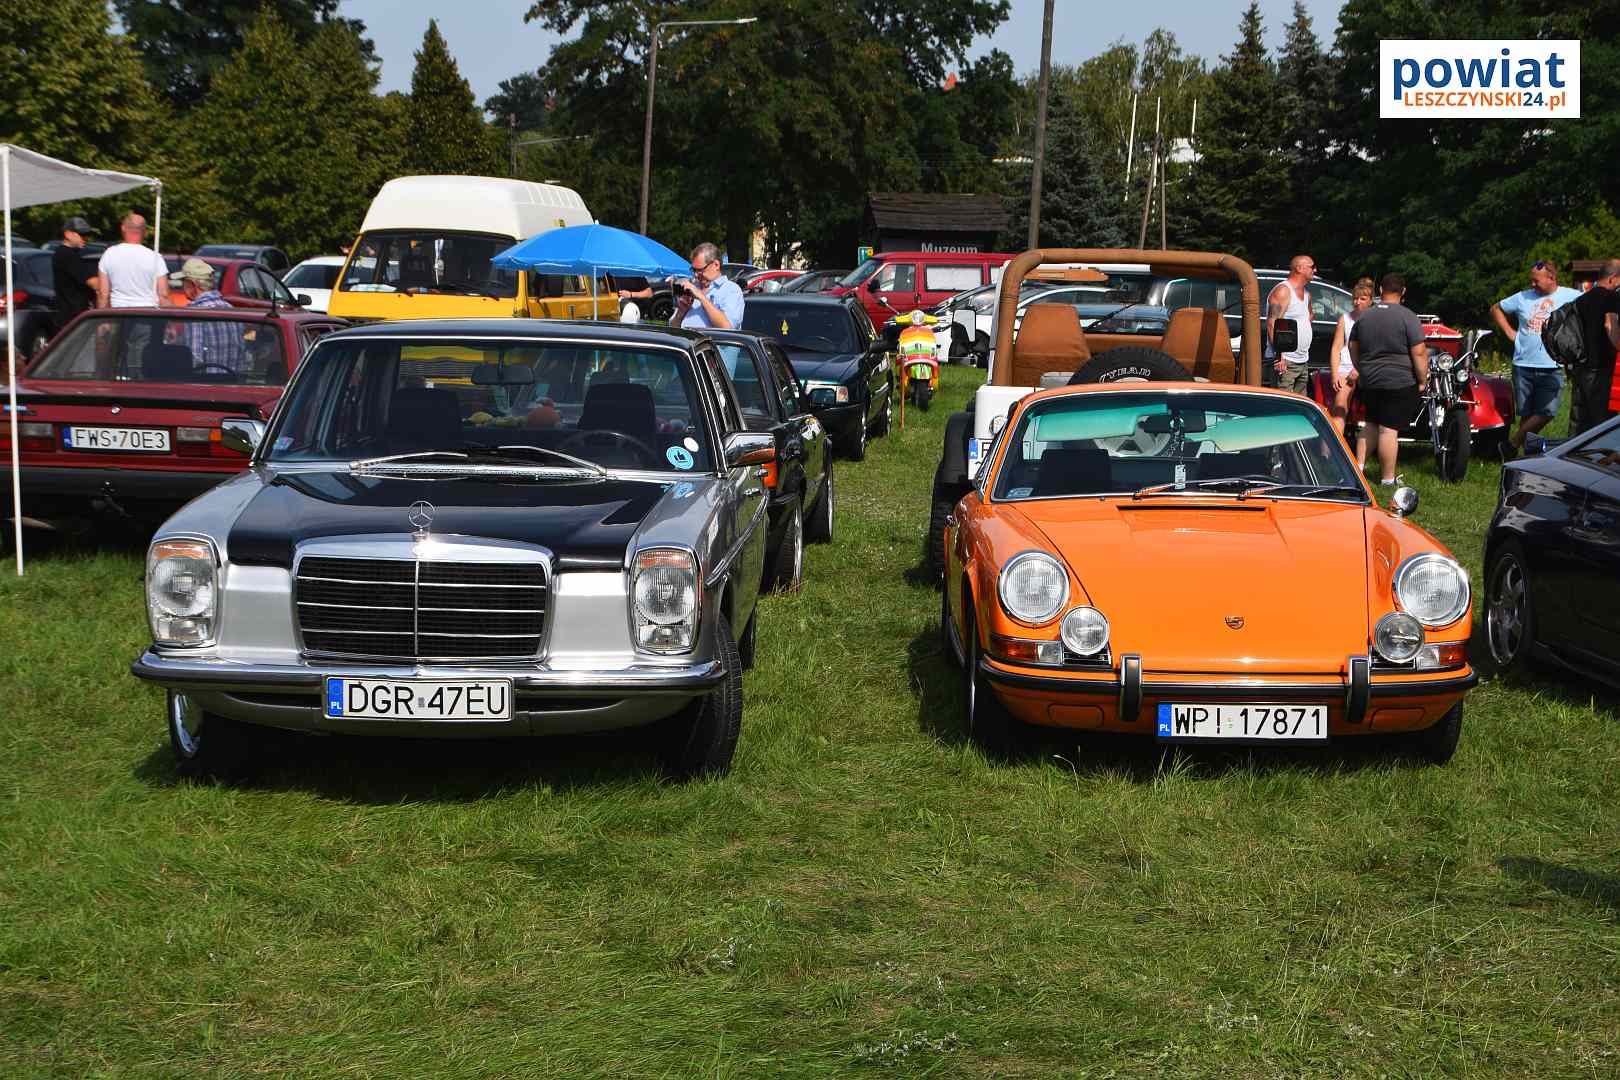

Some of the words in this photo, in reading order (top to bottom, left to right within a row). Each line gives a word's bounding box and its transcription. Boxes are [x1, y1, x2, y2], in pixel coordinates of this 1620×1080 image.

[920, 243, 978, 254] Muzeum
[75, 429, 111, 447] FWS
[118, 431, 165, 449] 70E3
[348, 683, 414, 715] DGR
[427, 685, 505, 715] 47EU
[1159, 724, 1170, 732] PL
[1239, 708, 1320, 735] 17871
